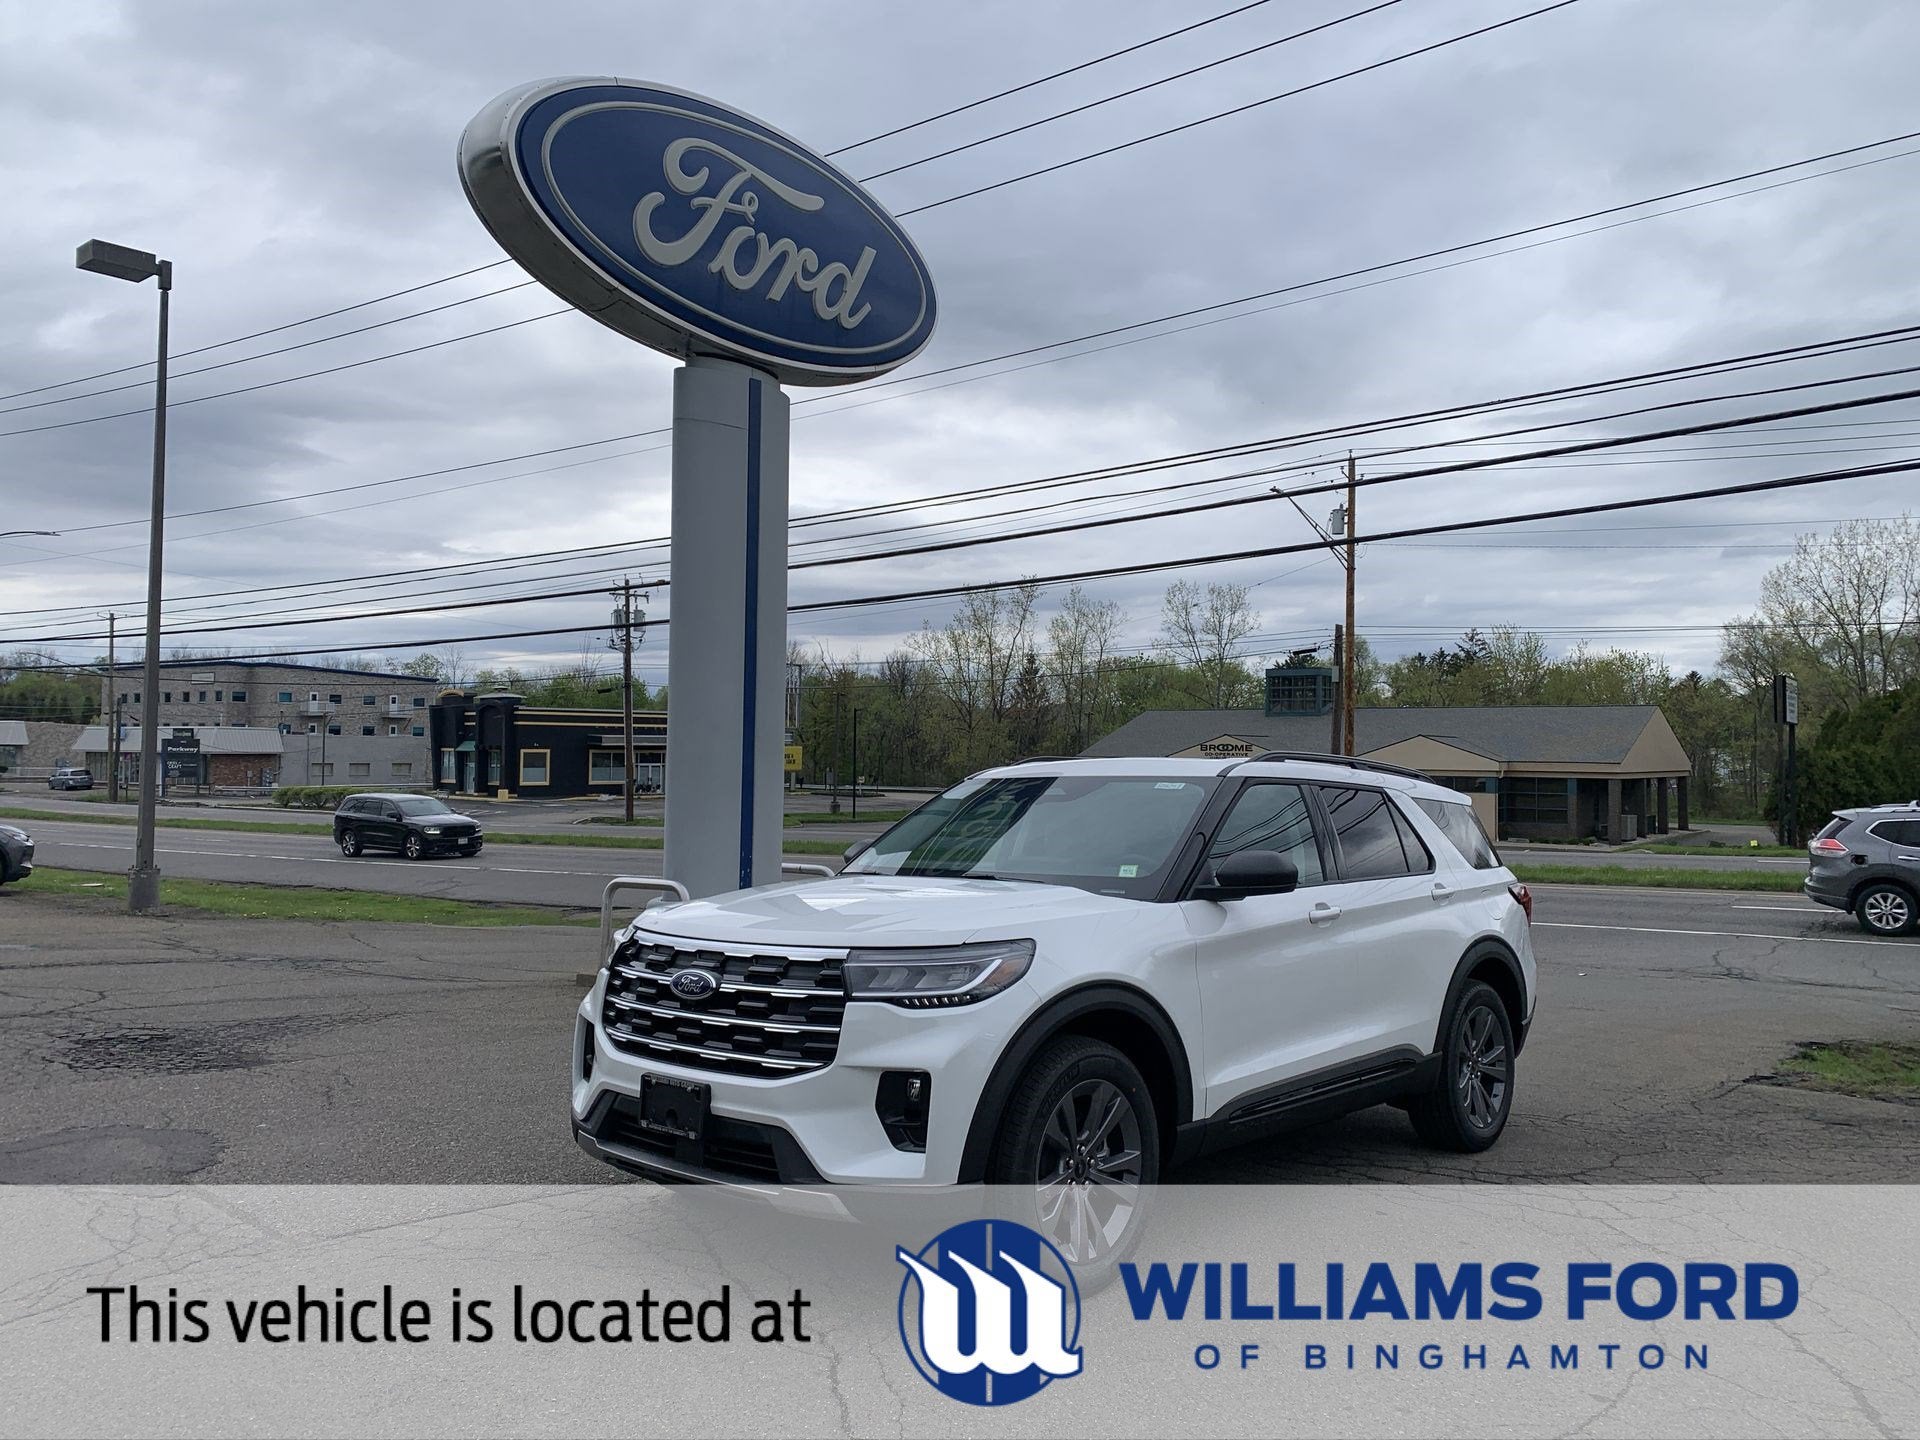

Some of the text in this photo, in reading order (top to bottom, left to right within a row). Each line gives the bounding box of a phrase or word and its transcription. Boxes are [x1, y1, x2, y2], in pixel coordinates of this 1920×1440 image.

[633, 137, 877, 329] Ford
[1200, 743, 1253, 752] BROOME
[678, 974, 704, 992] Ford
